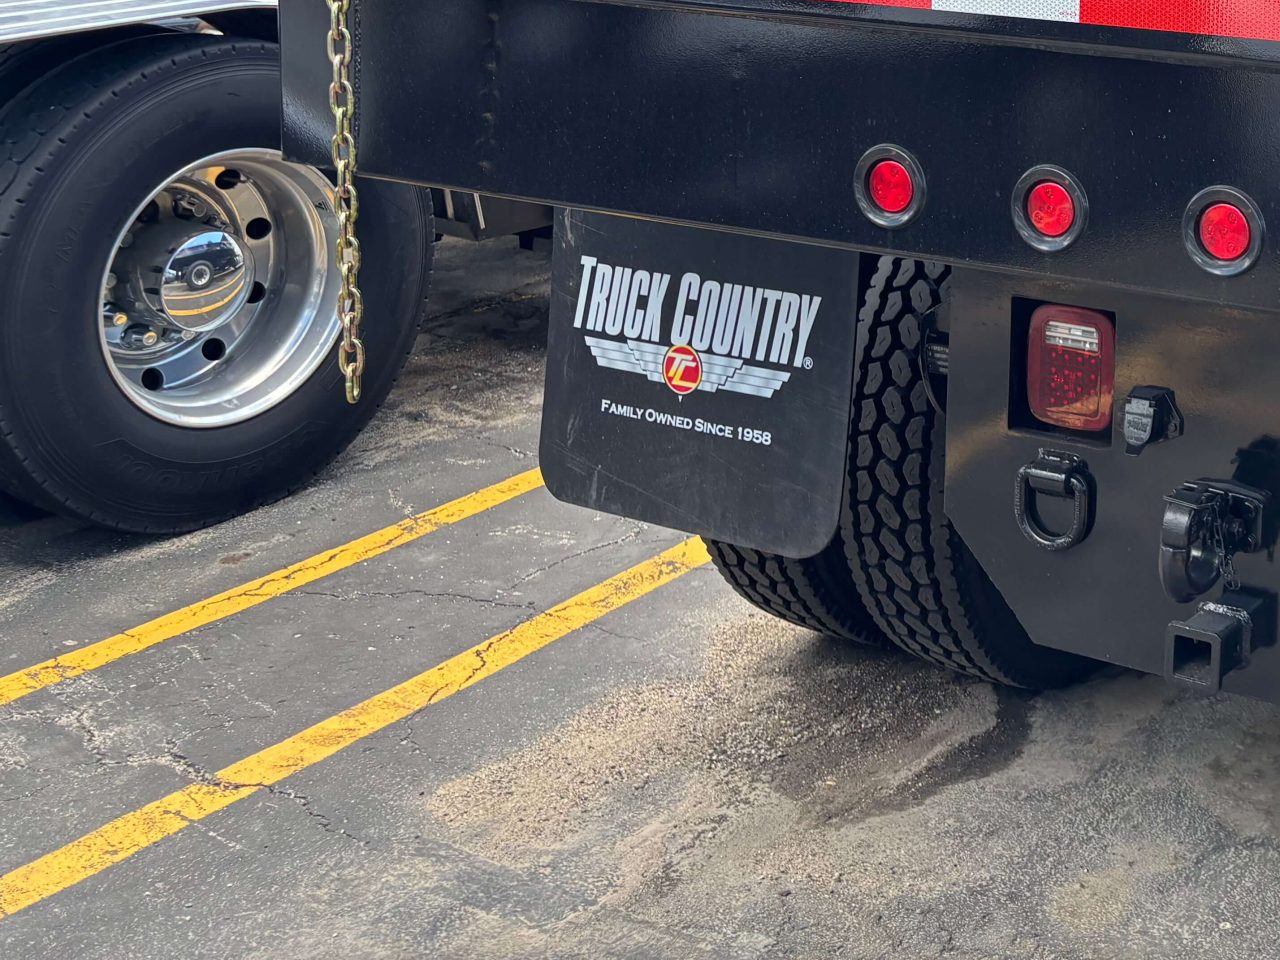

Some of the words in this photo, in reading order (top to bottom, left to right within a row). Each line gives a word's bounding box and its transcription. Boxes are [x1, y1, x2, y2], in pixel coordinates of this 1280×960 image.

[573, 255, 671, 343] TRUCK
[670, 272, 822, 368] COUNTRY
[601, 399, 644, 419] FAMILY
[645, 408, 692, 430] OWNED
[694, 418, 733, 438] SINCE
[737, 427, 772, 445] 1958
